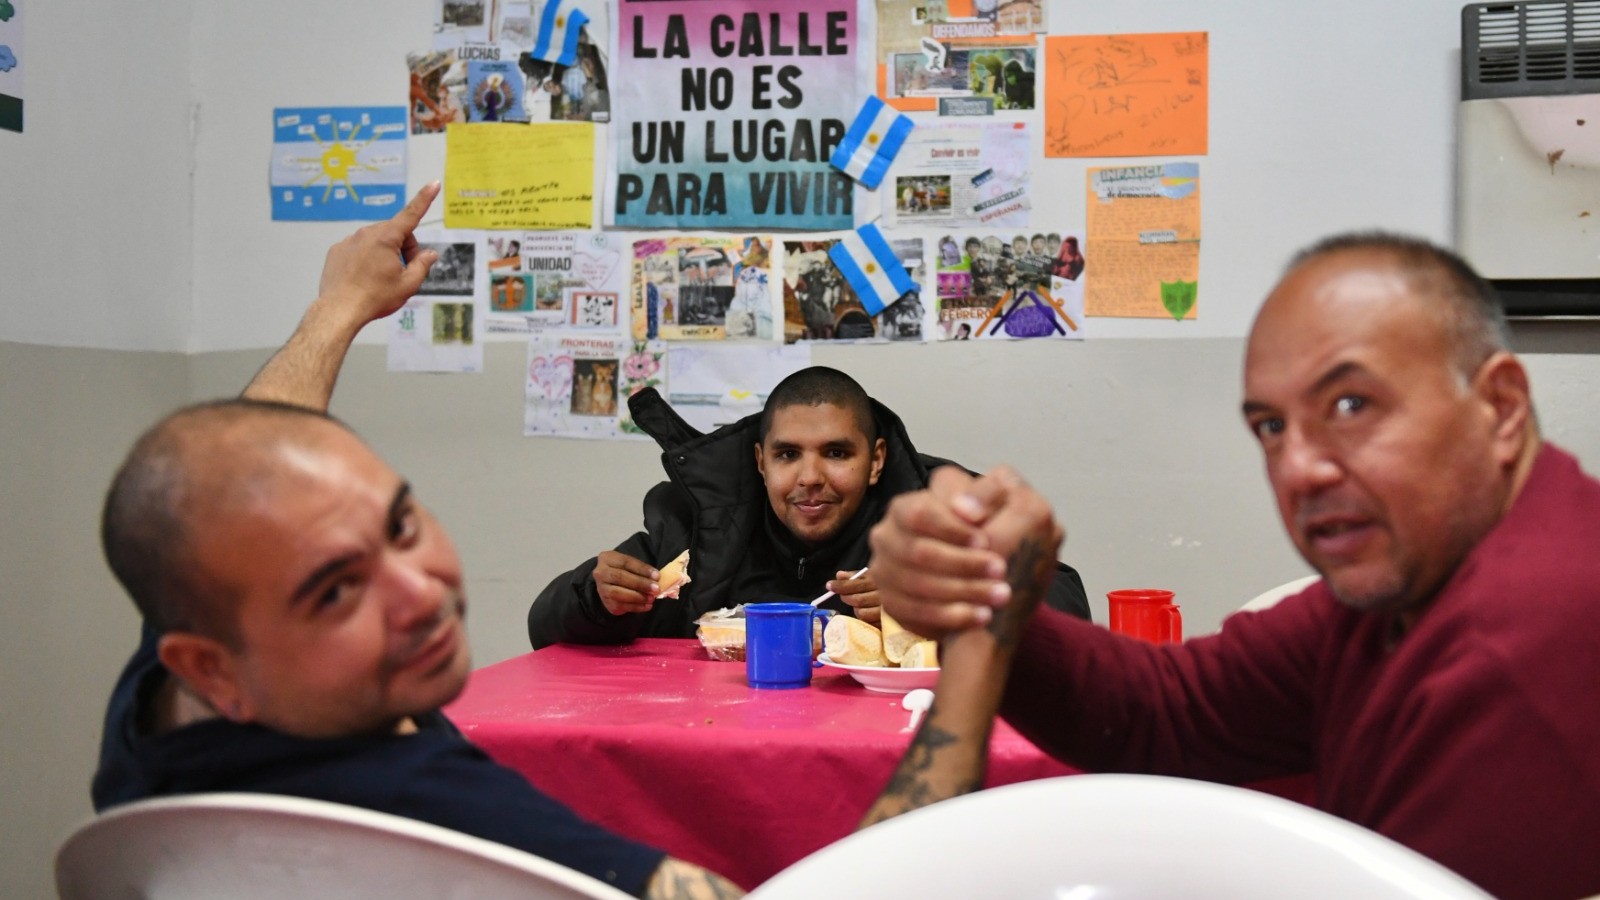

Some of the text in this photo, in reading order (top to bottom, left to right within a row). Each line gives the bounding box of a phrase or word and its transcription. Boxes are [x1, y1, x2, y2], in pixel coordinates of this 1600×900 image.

[633, 11, 848, 58] LA CALLE
[933, 23, 995, 38] DEFENDAMOS
[458, 45, 501, 61] LUCHAS
[681, 65, 803, 111] NO ES
[632, 121, 685, 164] UN
[705, 119, 846, 163] LUGAR
[616, 171, 853, 216] PARA VIVIR
[528, 257, 572, 271] UNIDAD
[940, 308, 992, 320] FEBRERO
[561, 338, 615, 349] FRONTERAS
